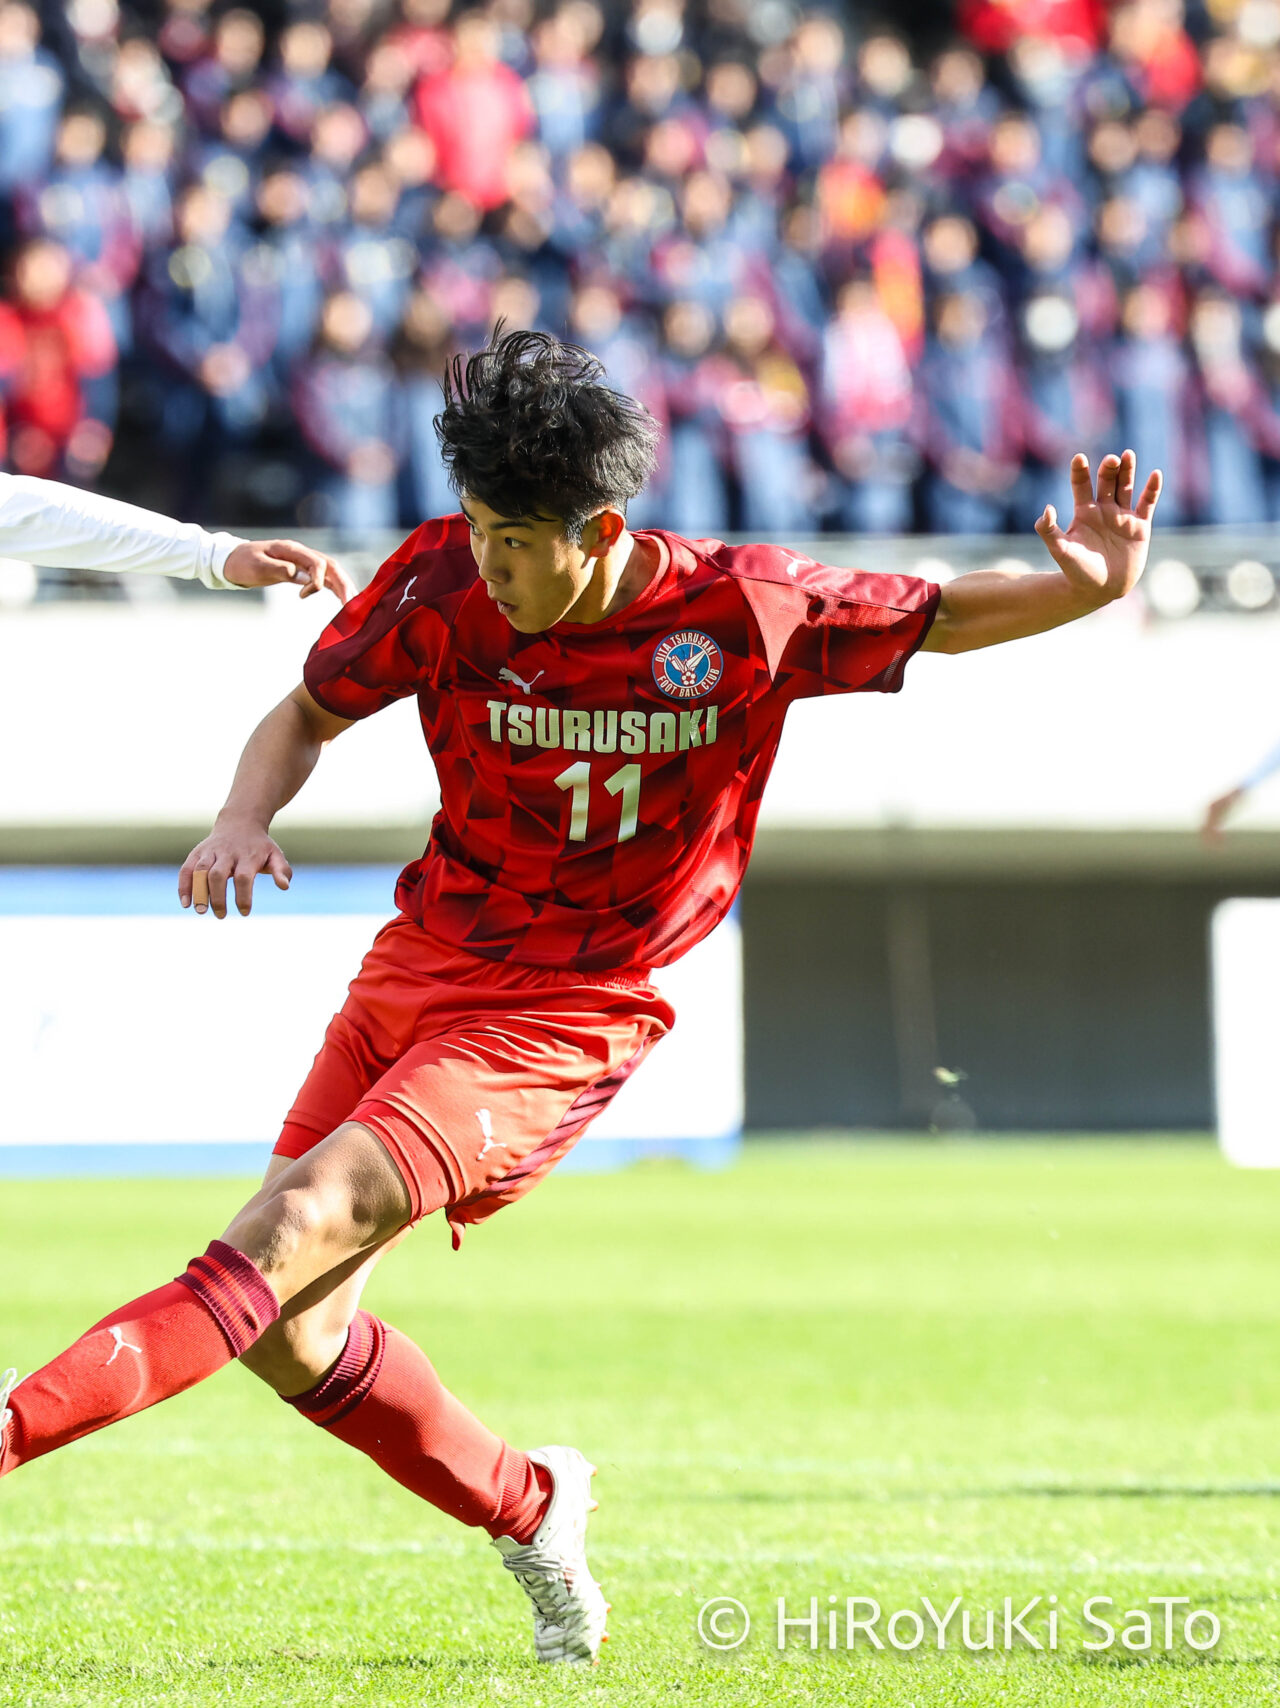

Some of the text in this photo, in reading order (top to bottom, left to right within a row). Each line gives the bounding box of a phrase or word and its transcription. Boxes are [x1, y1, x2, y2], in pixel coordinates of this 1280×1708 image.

[655, 632, 718, 662] OITA TSURUSAKI
[657, 668, 720, 697] FOOT BALL CLUB
[486, 700, 719, 754] TSURUSAKI
[553, 761, 642, 842] 11
